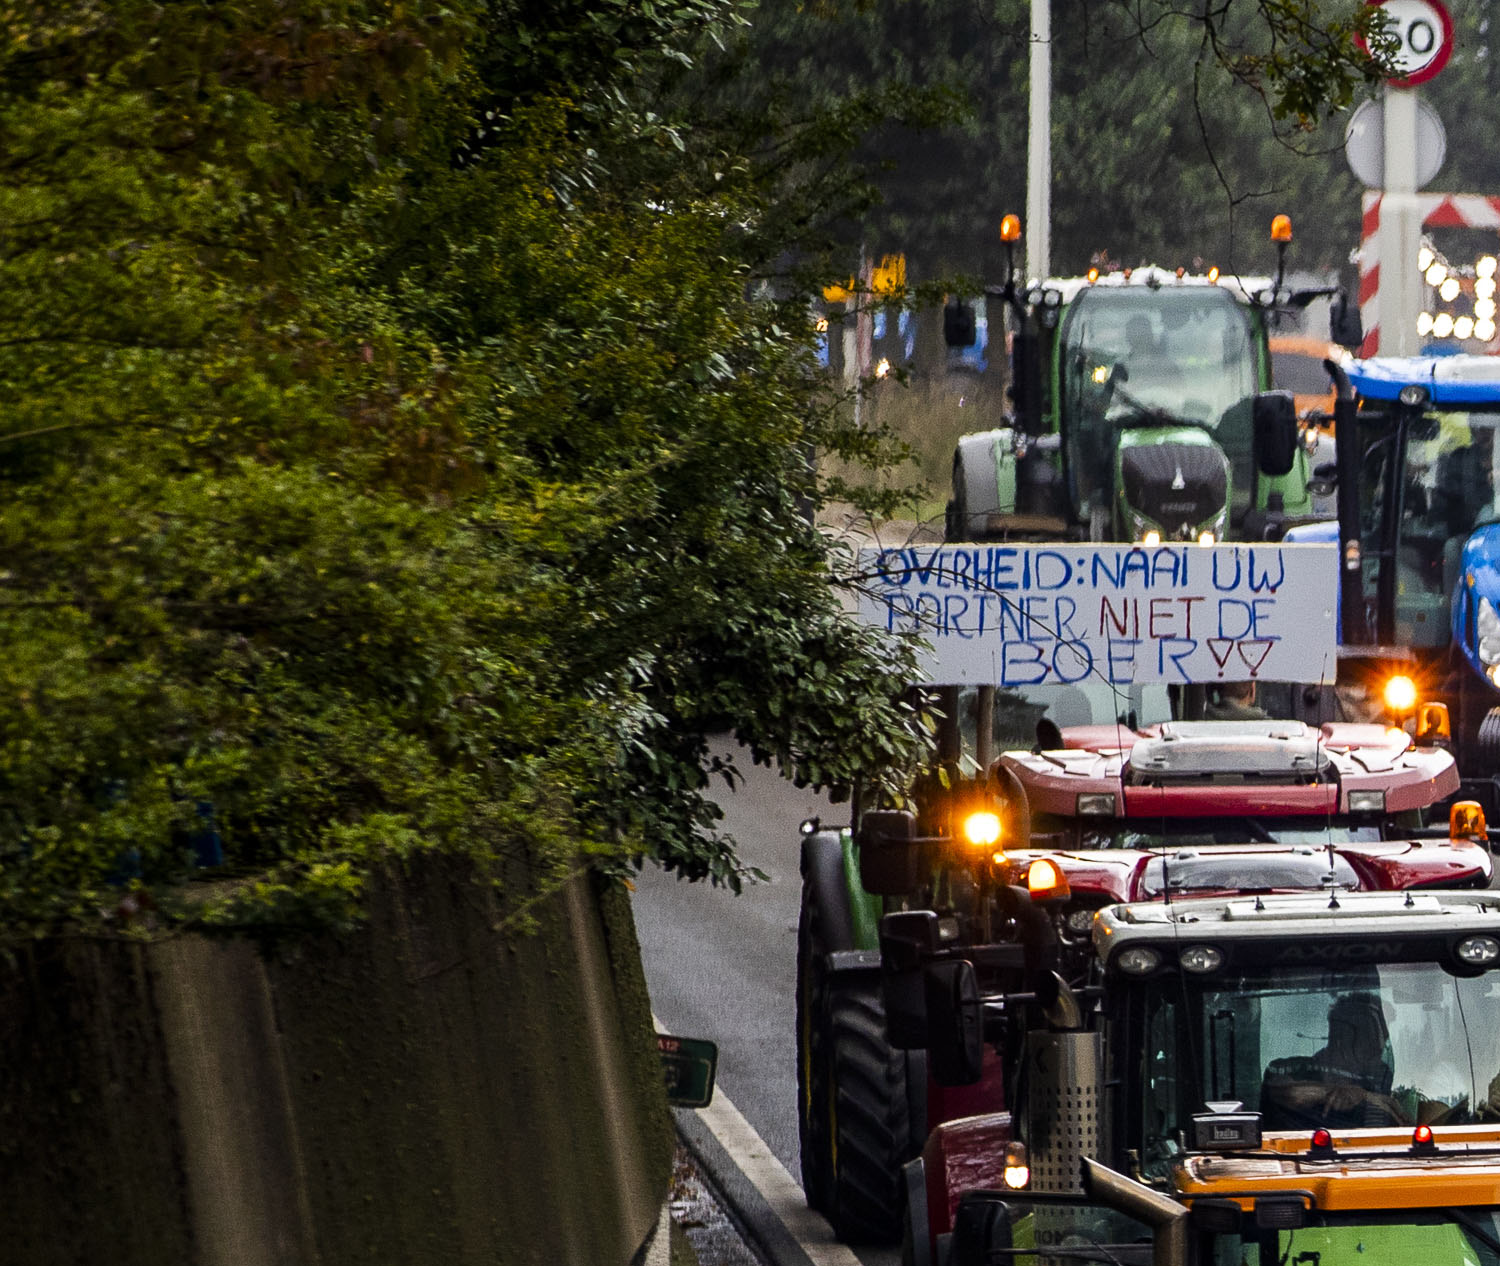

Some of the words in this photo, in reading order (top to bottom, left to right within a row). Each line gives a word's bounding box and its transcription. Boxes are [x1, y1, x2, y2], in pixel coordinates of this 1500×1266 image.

[1212, 547, 1285, 593] UW
[885, 592, 1077, 642] PARTNER
[1100, 595, 1206, 640] NIET
[1218, 599, 1282, 641] DE
